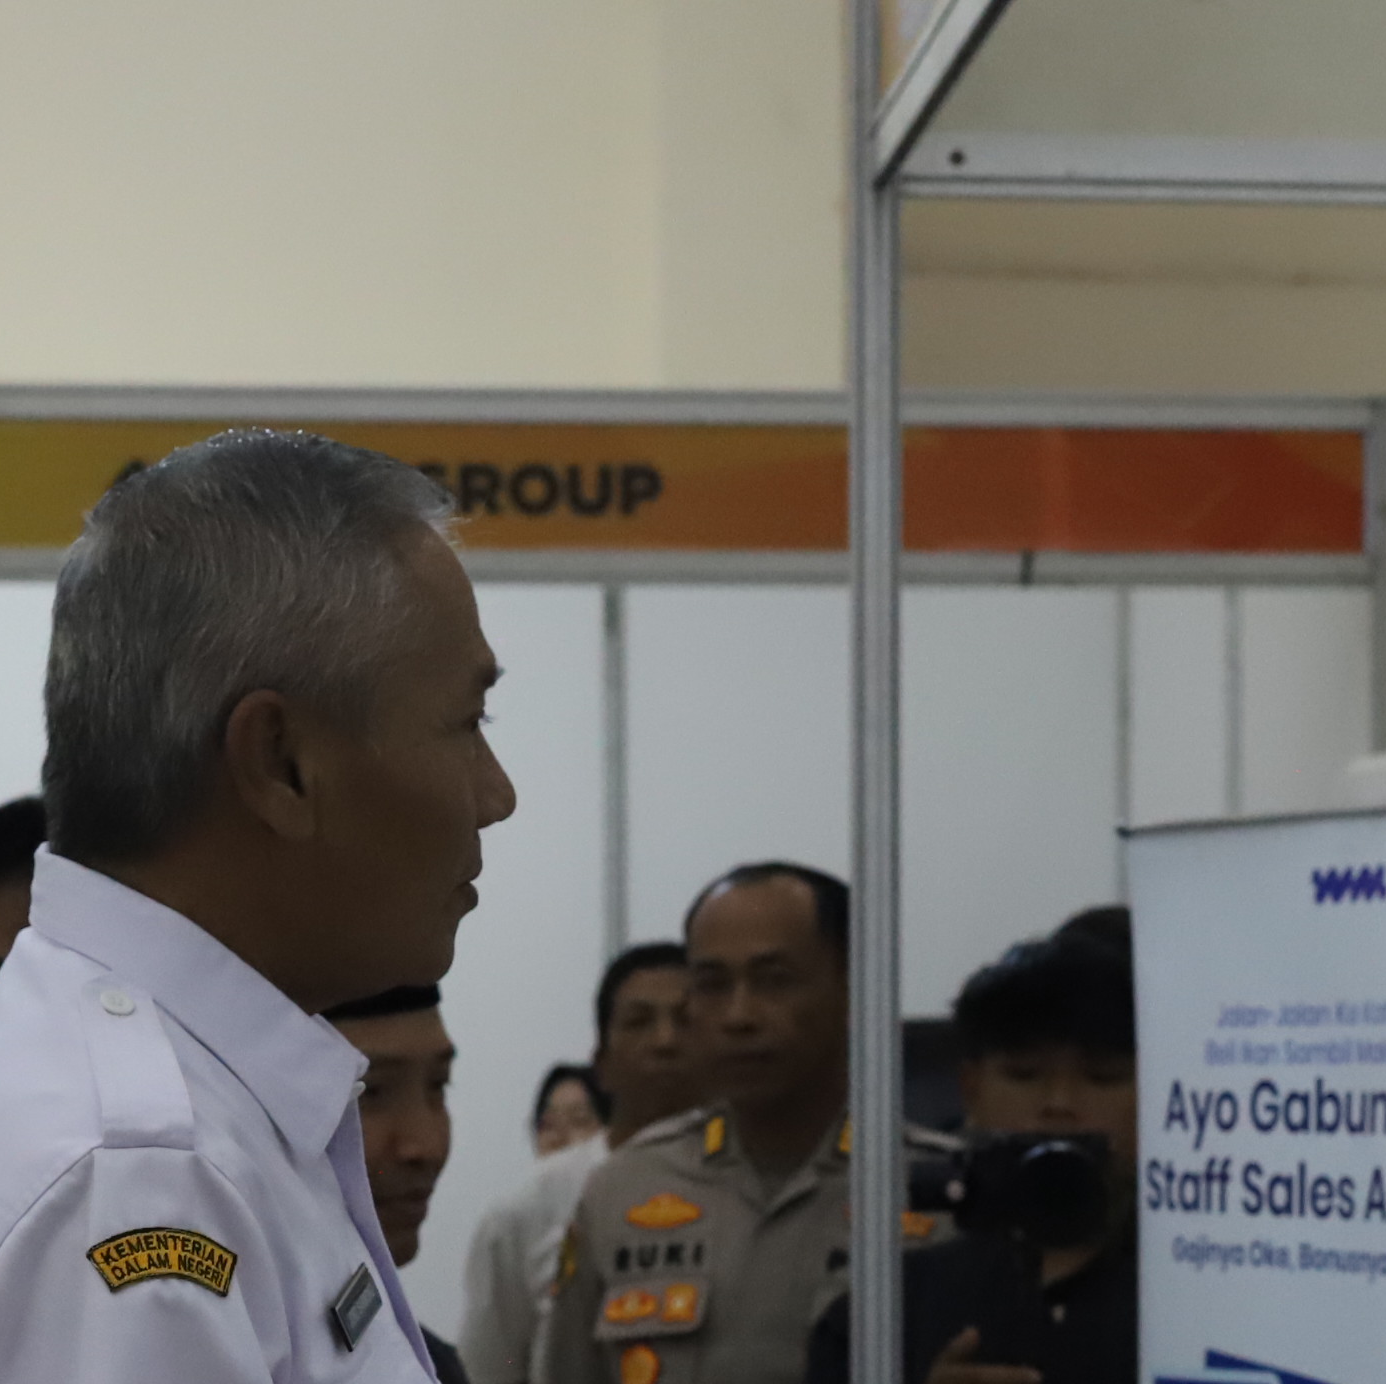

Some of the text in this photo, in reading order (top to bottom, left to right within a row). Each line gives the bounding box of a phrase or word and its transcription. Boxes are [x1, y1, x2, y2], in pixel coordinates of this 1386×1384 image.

[1164, 1080, 1239, 1150] Ayo
[1145, 1157, 1231, 1213] Staff
[1242, 1161, 1355, 1220] Sales
[100, 1233, 229, 1271] KEMENTERIAN
[178, 1254, 224, 1288] NEGERI
